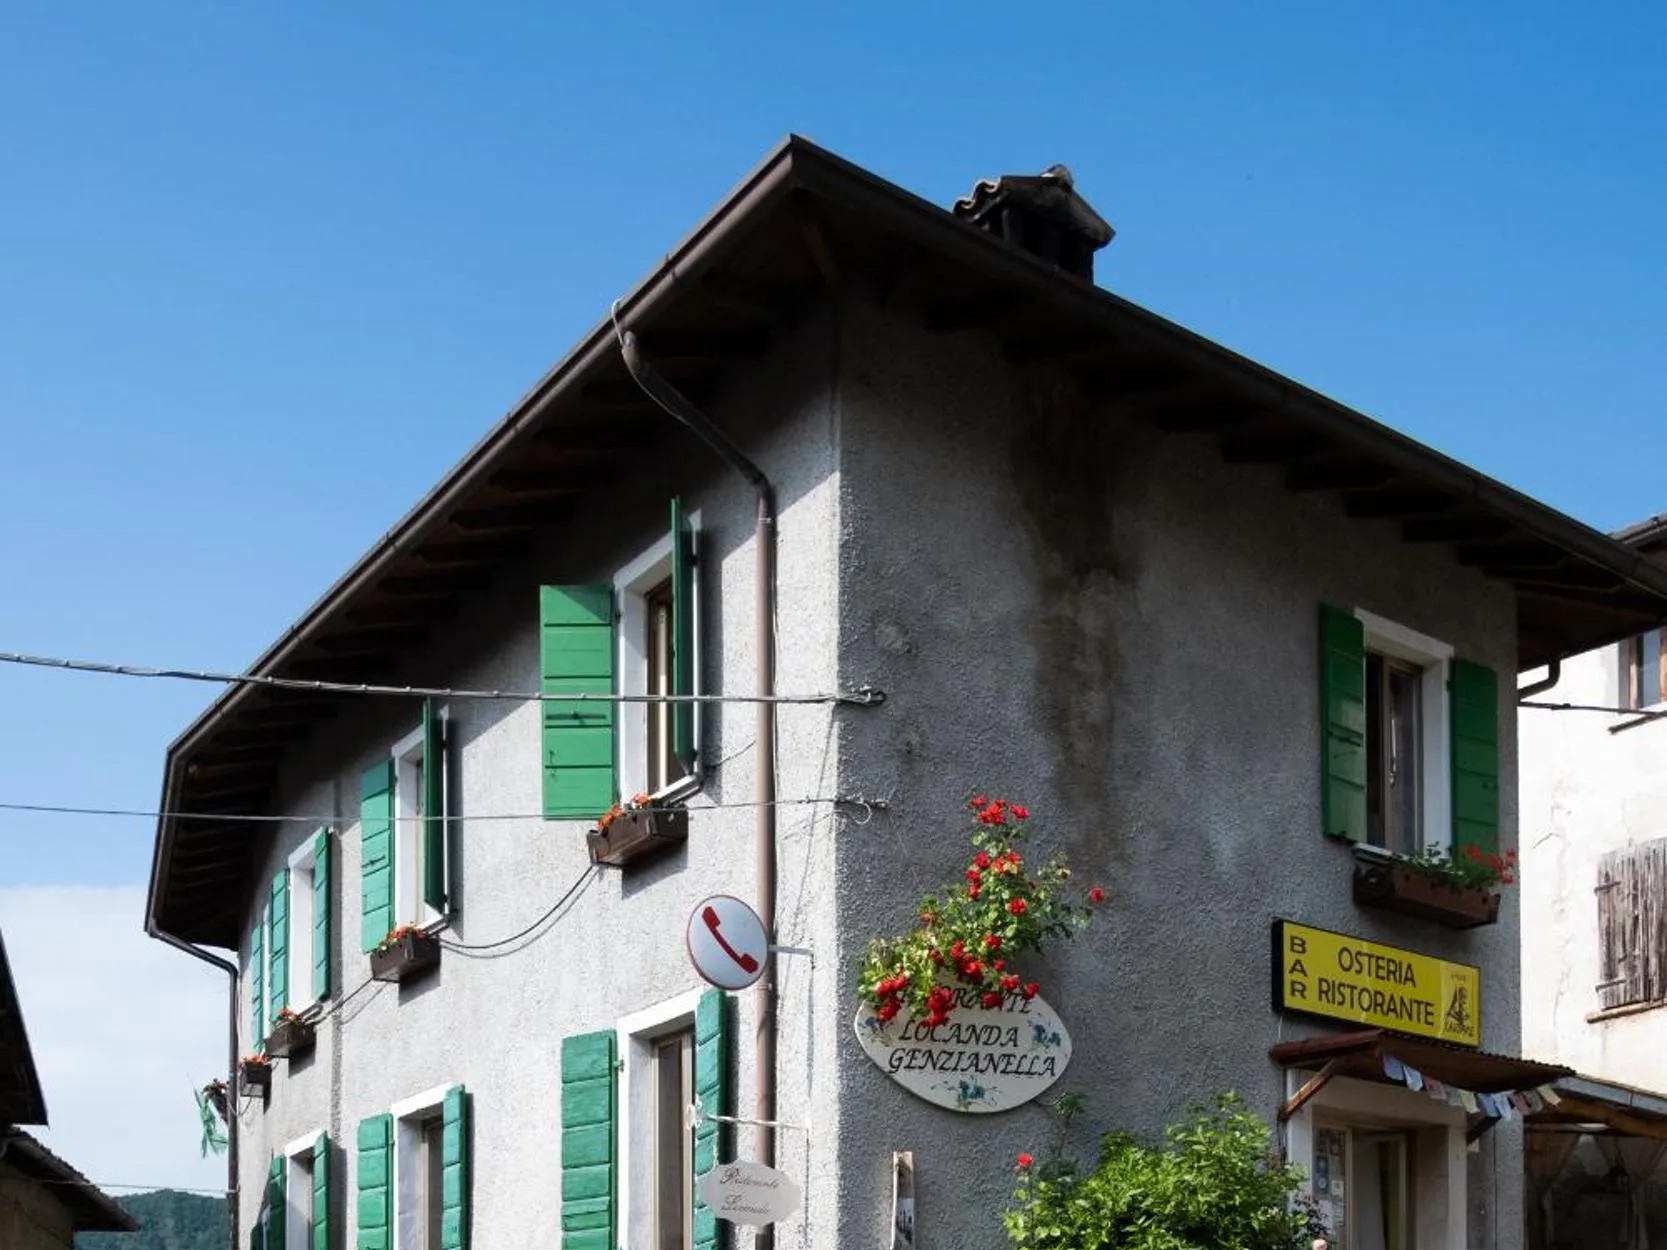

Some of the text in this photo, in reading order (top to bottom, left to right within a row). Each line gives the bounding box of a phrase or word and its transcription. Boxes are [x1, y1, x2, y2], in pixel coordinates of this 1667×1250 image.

[1288, 935, 1308, 999] BAR
[1338, 946, 1416, 987] OSTERIA
[1318, 976, 1435, 1026] RISTORANTE
[898, 1019, 1019, 1047] LOCANDA
[888, 1048, 1056, 1077] GENZIANELLA
